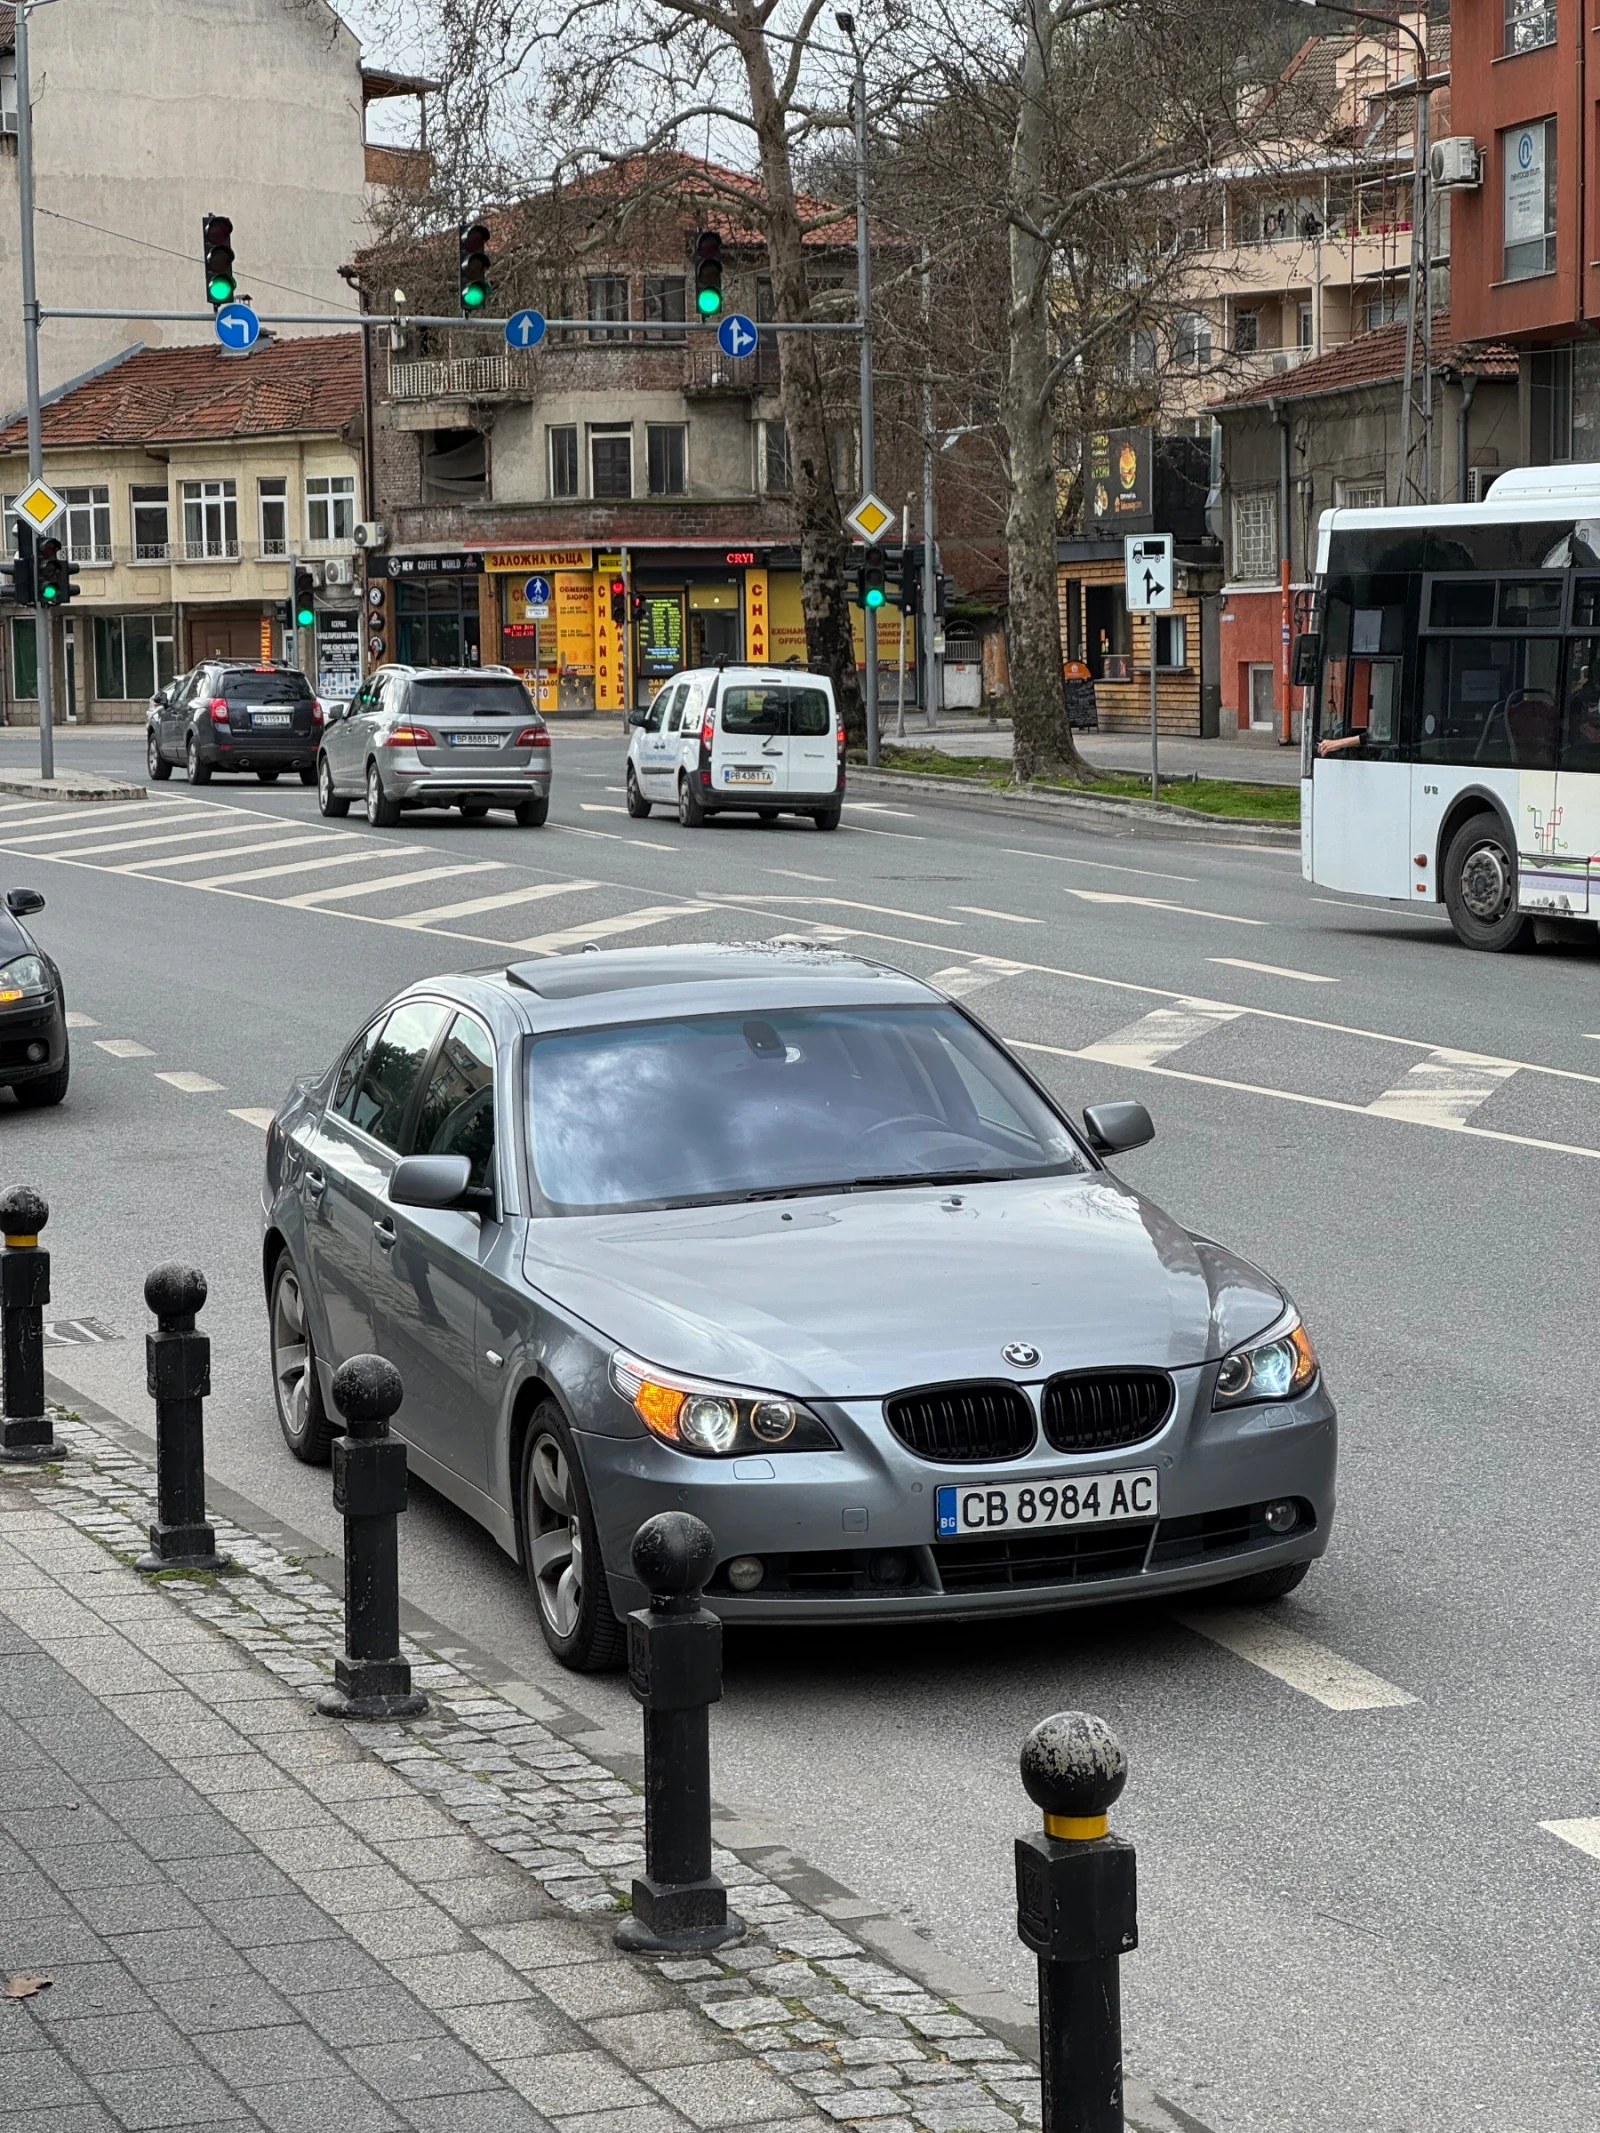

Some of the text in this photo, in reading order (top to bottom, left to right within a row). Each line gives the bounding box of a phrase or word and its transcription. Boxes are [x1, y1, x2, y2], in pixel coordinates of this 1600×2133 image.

[402, 561, 414, 571] NEW
[418, 560, 438, 570] COFFEE
[442, 559, 461, 570] WORLD
[492, 554, 546, 567] ЗАЛОЖНА
[549, 552, 584, 566] КЪЩА
[751, 584, 764, 656] CHAN
[597, 585, 608, 698] CHANGE
[731, 771, 772, 781] PB 4381 TA
[940, 1476, 1152, 1529] BG CB 8984 AC
